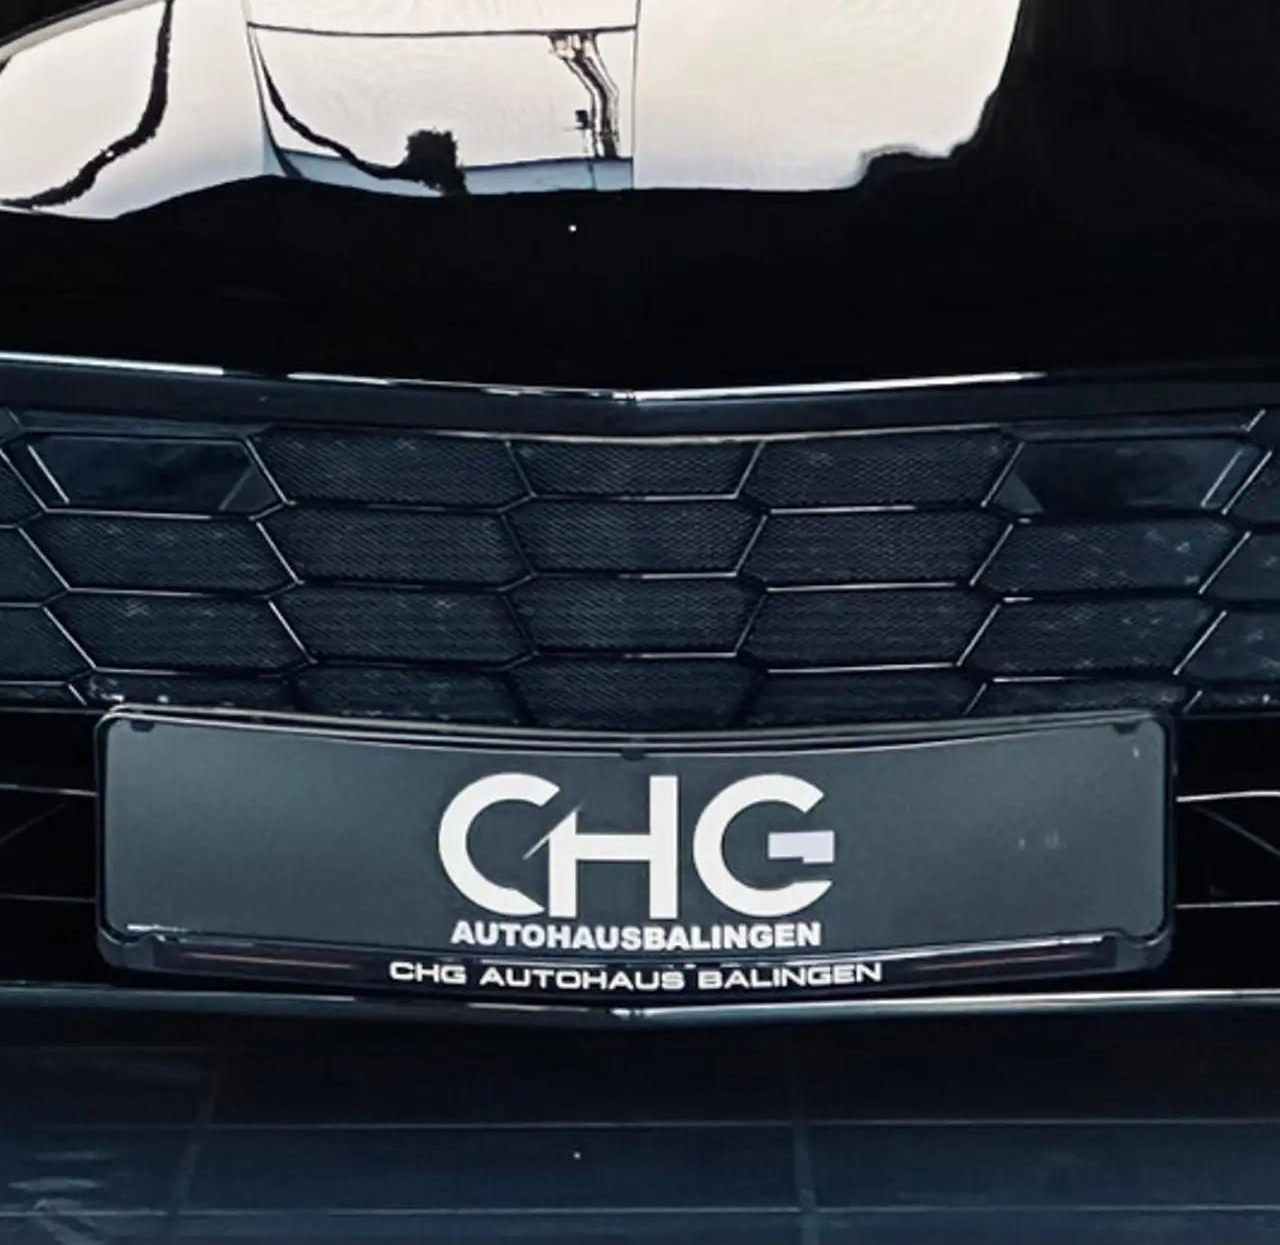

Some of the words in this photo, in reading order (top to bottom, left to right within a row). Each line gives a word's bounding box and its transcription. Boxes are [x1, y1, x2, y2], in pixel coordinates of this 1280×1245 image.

[438, 772, 835, 920] CHG
[451, 920, 821, 951] AUTOHAUSBALINGEN
[389, 961, 467, 984] CHG
[479, 967, 686, 990] AUTOHAUS
[697, 962, 882, 990] BALINGEN
